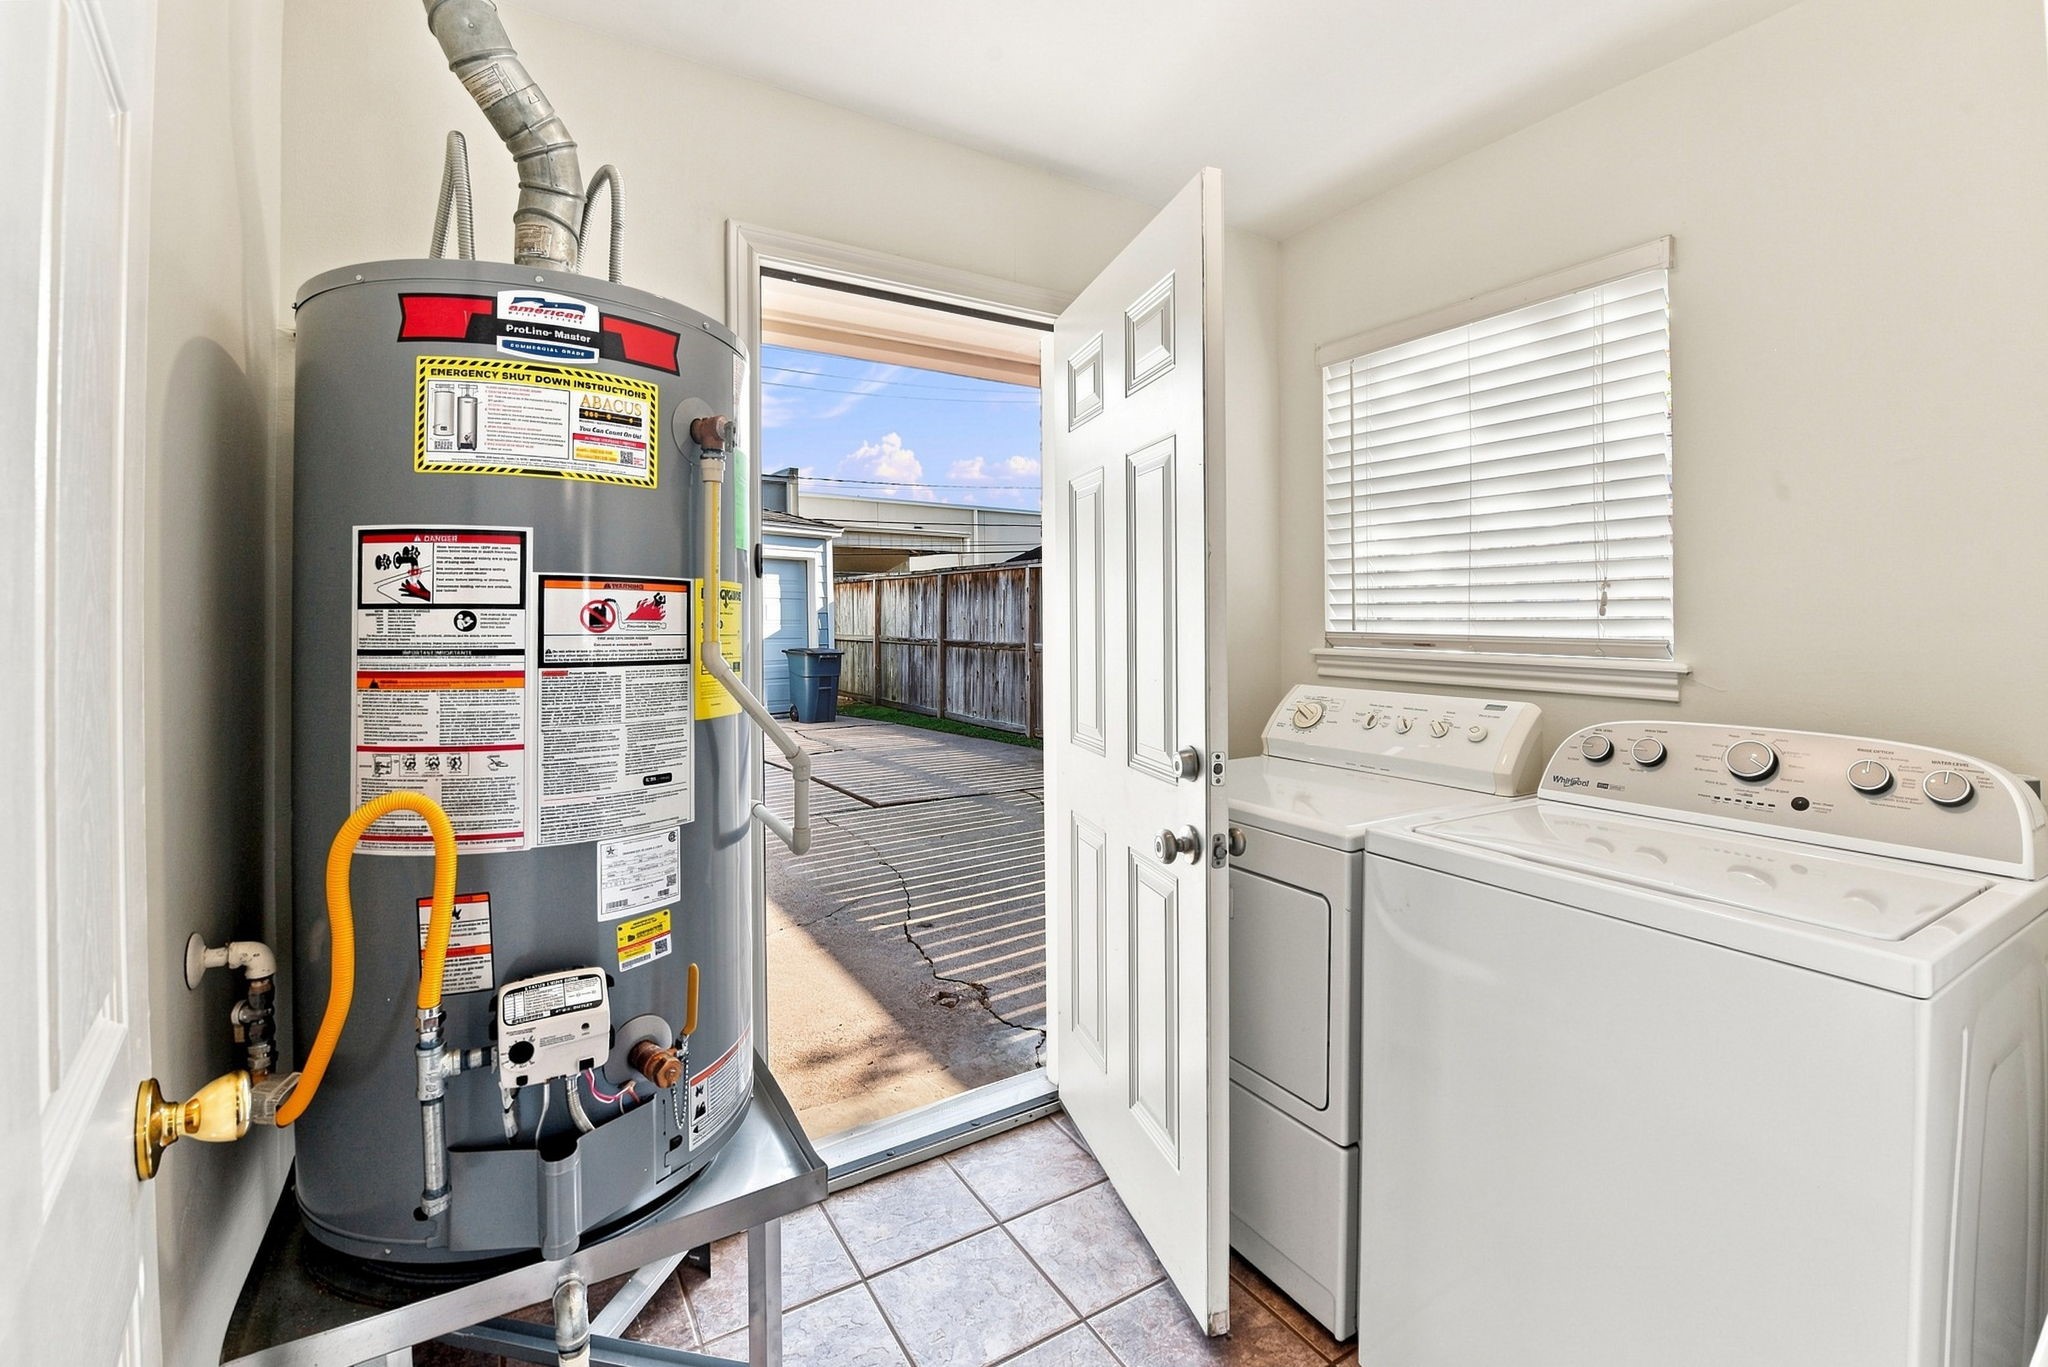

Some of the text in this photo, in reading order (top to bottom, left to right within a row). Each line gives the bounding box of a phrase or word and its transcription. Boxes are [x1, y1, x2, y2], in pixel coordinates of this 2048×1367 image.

[508, 305, 585, 320] american
[506, 324, 591, 343] ProLine Master
[510, 343, 585, 357] COMMERCIAL GRADE
[430, 368, 647, 400] EMERGENCY SHUT DOWN INSTRUCTIONS
[580, 394, 642, 417] ABACUS
[605, 429, 623, 437] Count
[1553, 775, 1590, 788] Whirlpool
